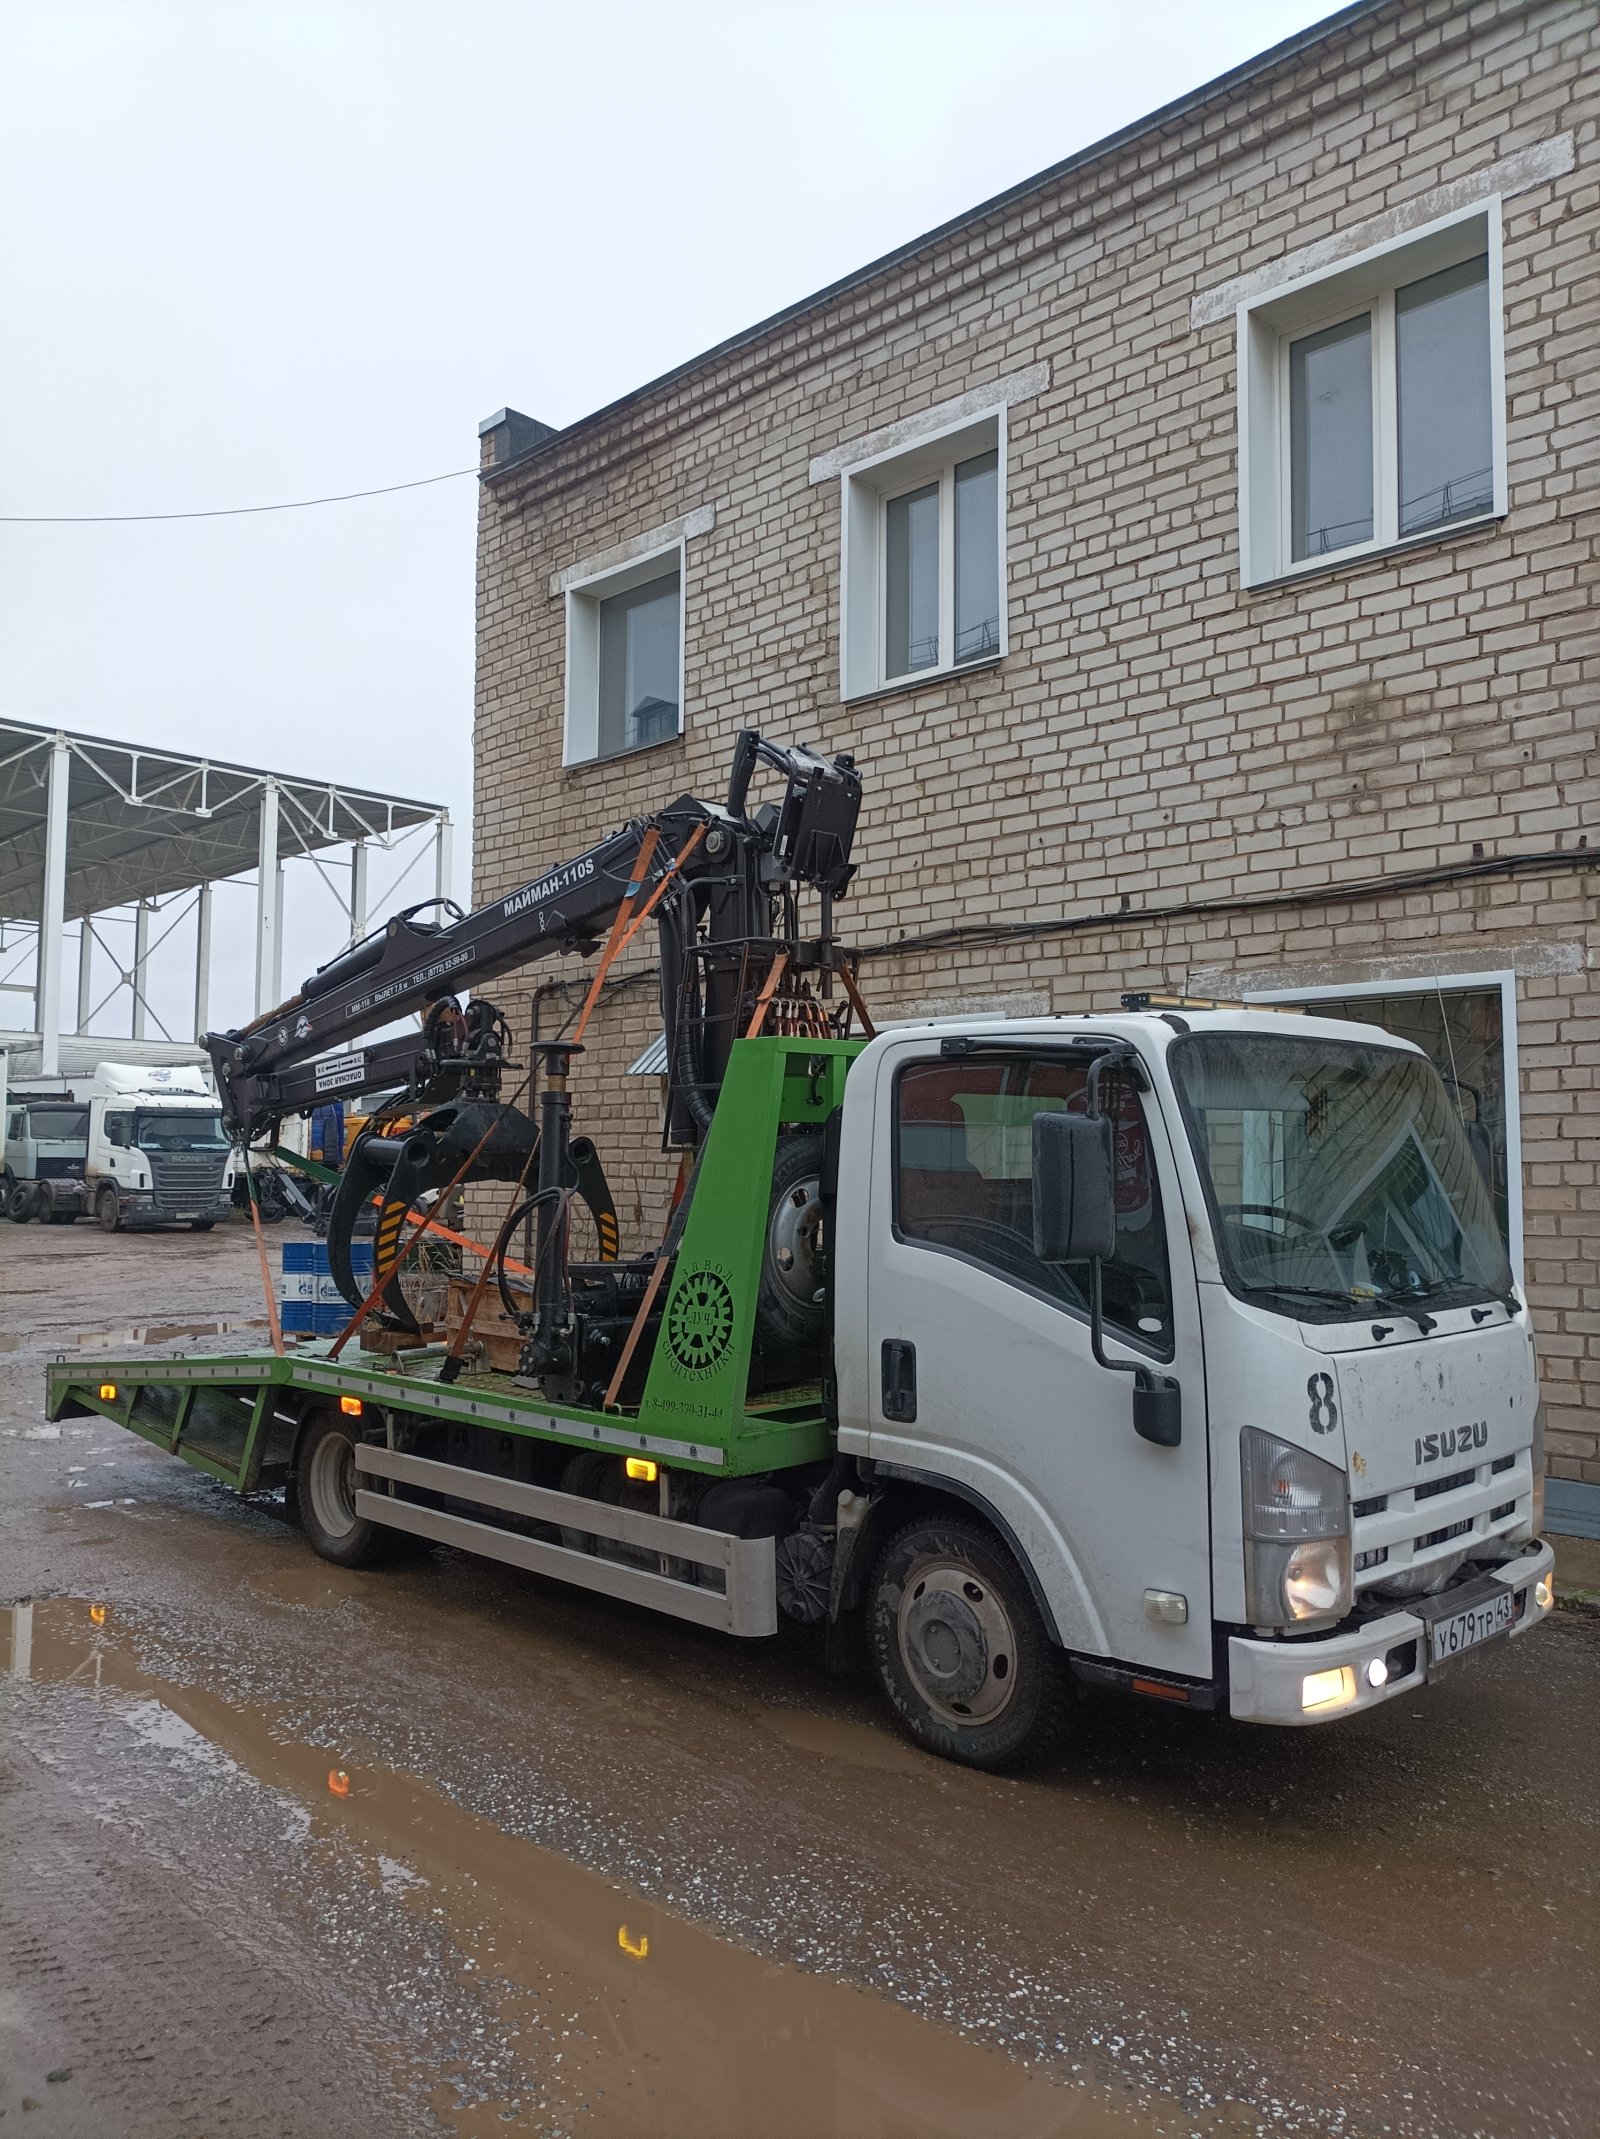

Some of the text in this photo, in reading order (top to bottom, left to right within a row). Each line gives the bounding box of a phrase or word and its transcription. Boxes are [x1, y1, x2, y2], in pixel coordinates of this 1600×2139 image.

[503, 858, 595, 917] МАЙМАН-110S
[374, 987, 394, 1002] ВЫЛЕТ
[428, 965, 444, 980] (8772)
[445, 952, 469, 969] 52-50-00
[318, 1071, 362, 1089] ОПАСНАЯ ЗОНА
[1306, 1371, 1338, 1435] 8
[1414, 1420, 1488, 1466] ISUZU
